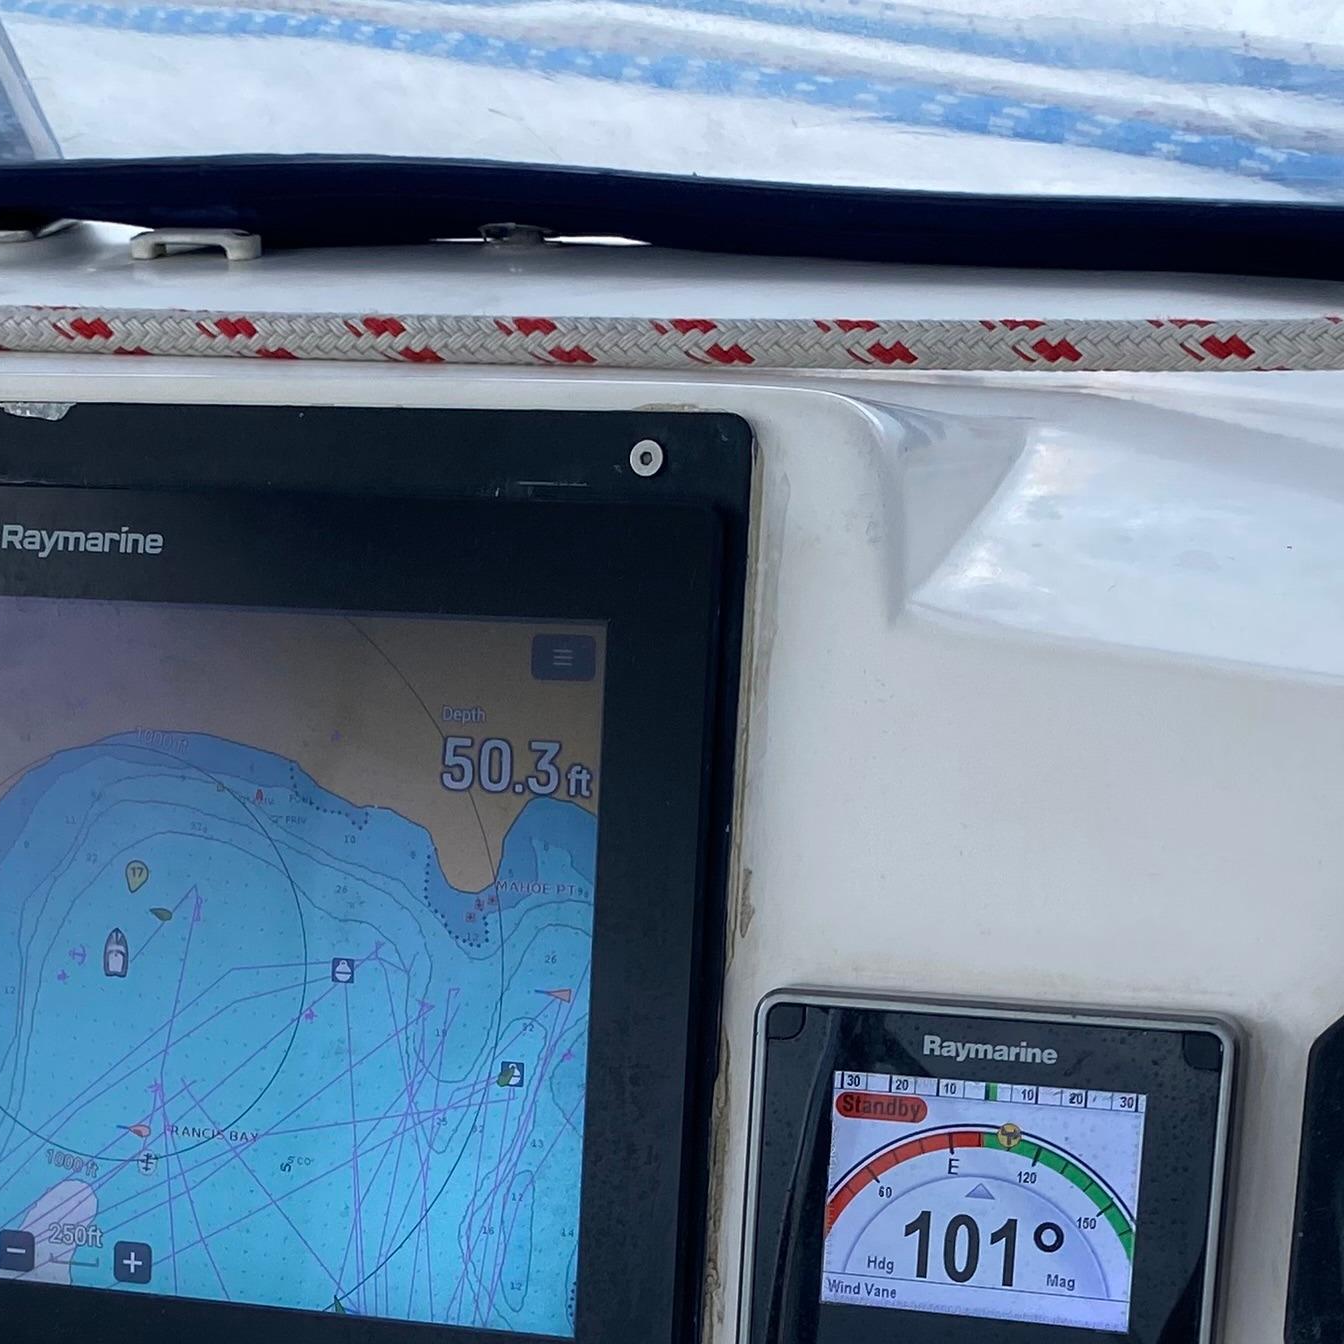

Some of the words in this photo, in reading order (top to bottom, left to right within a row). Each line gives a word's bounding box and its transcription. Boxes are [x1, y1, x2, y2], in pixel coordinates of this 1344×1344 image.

[1, 525, 164, 557] Raymarine
[442, 705, 486, 724] Depth
[440, 736, 562, 795] 50.3
[567, 765, 594, 798] ft
[130, 867, 144, 878] 17
[496, 880, 551, 895] MAHOE
[557, 884, 576, 896] PT
[923, 1034, 1059, 1065] Raymarine
[847, 1075, 861, 1087] 30
[895, 1079, 909, 1091] 20
[944, 1083, 956, 1095] 10
[1021, 1089, 1035, 1101] 10
[1069, 1092, 1083, 1105] 20
[1119, 1096, 1134, 1109] 30
[842, 1096, 920, 1120] Standby
[229, 1131, 258, 1142] BAY
[45, 1148, 84, 1173] 1000
[948, 1158, 960, 1175] E
[1017, 1171, 1037, 1184] 120
[878, 1186, 892, 1199] 60
[1076, 1217, 1097, 1230] 150
[48, 1222, 104, 1248] 250ft
[903, 1210, 1065, 1288] 101°
[867, 1255, 895, 1275] Hdg
[828, 1280, 861, 1296] Wind
[864, 1283, 896, 1299] Vane
[1046, 1273, 1075, 1291] Mag
